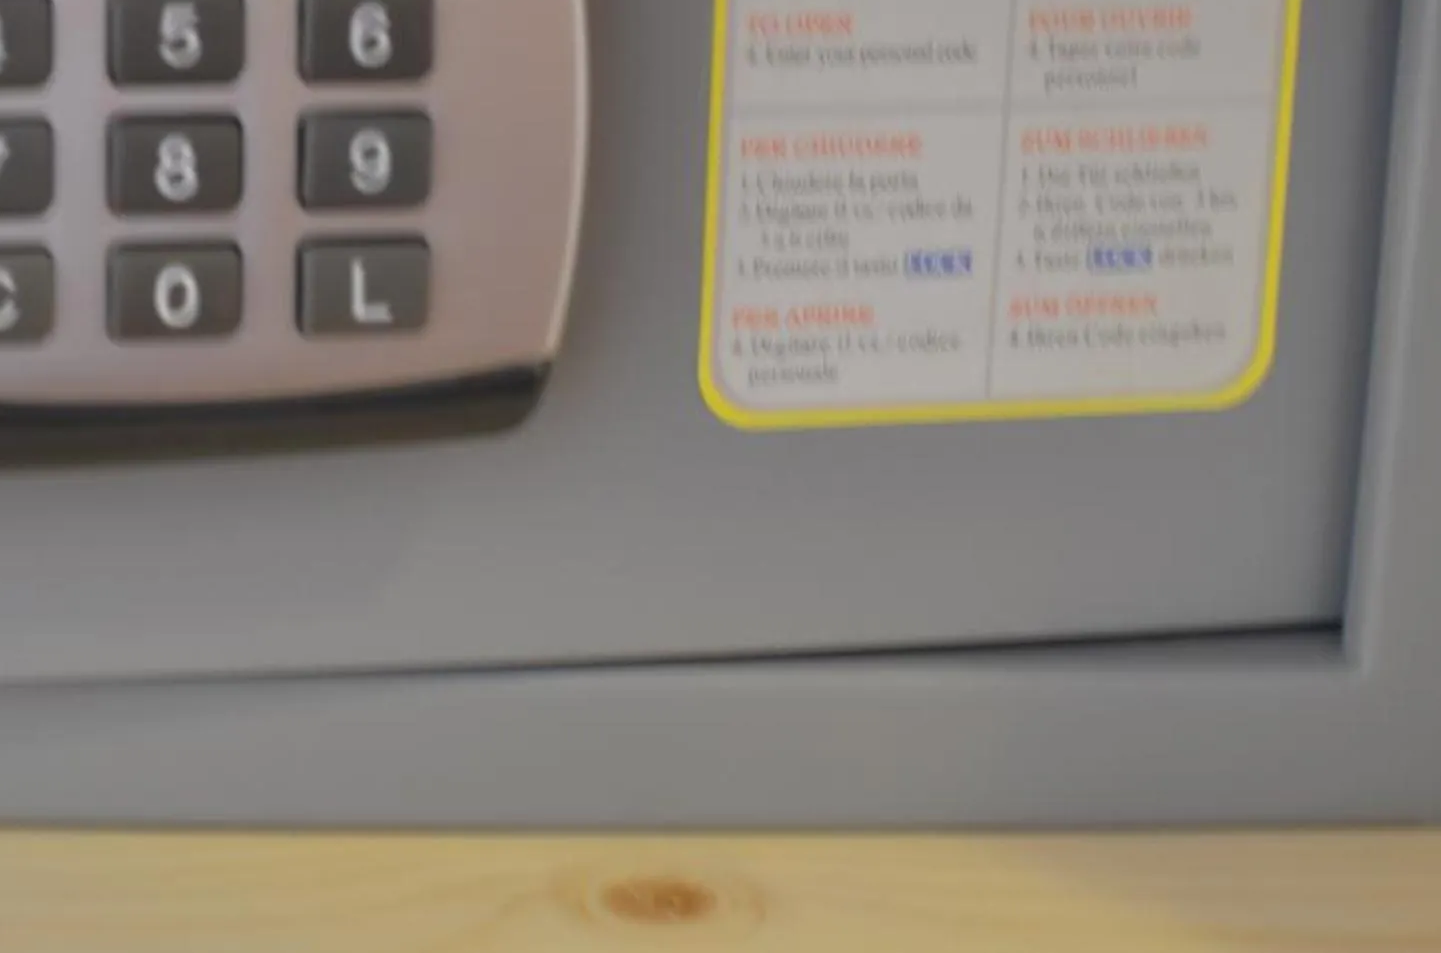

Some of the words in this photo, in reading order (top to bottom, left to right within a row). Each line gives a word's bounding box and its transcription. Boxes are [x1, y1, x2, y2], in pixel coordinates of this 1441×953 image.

[159, 0, 203, 71] 5
[348, 0, 393, 69] 6
[153, 131, 201, 203] 8
[348, 127, 393, 196] 9
[350, 256, 394, 325] L
